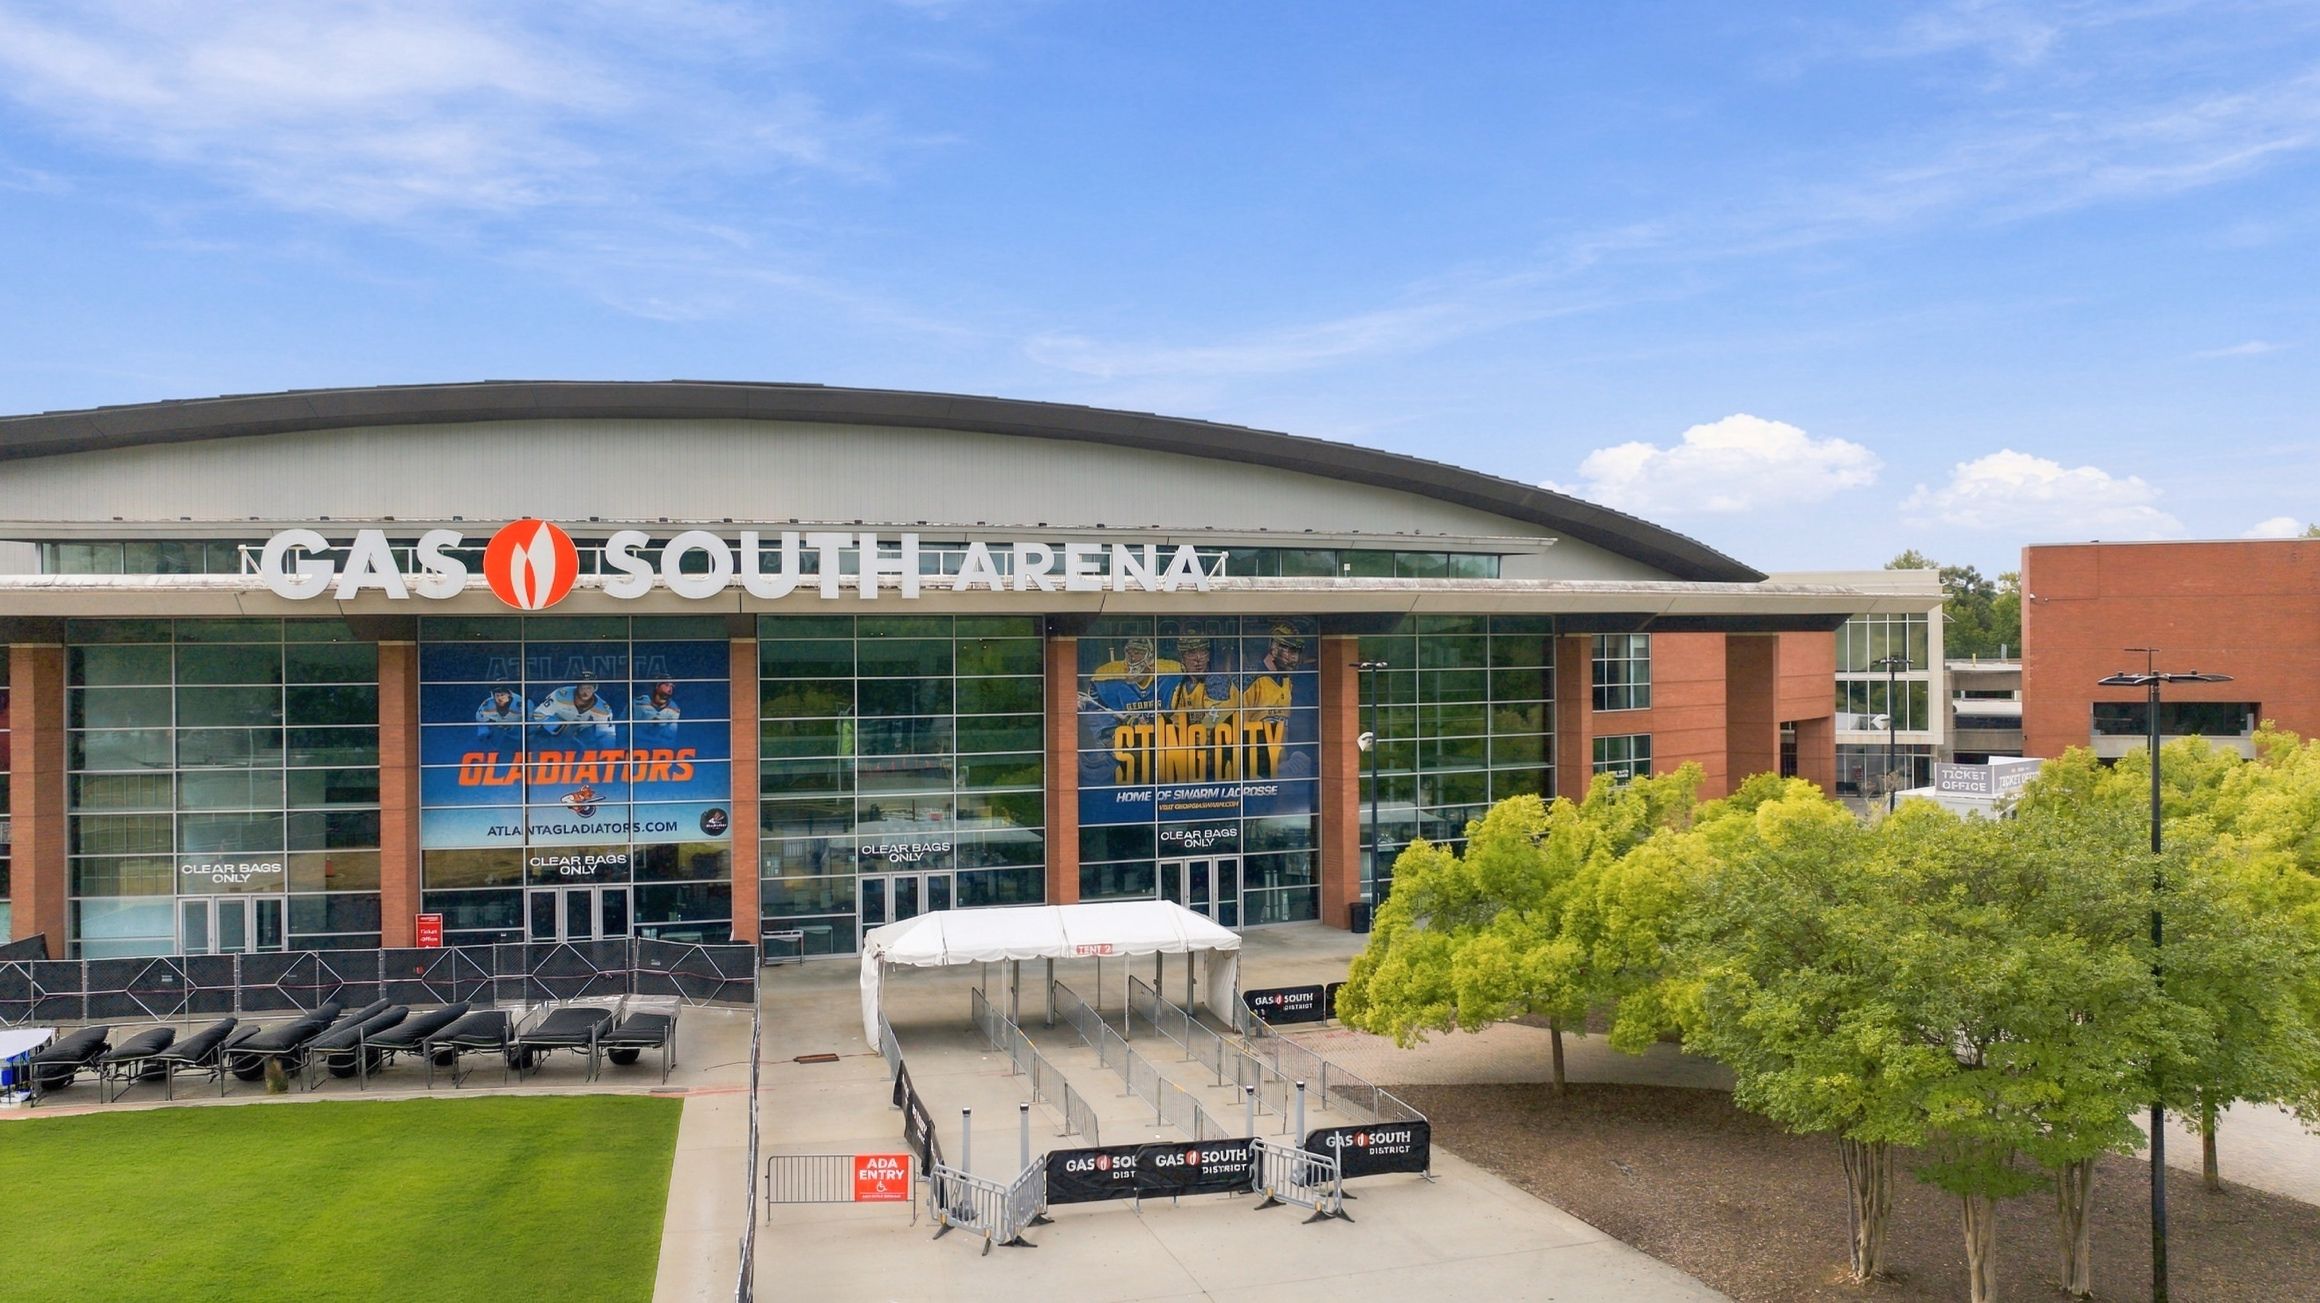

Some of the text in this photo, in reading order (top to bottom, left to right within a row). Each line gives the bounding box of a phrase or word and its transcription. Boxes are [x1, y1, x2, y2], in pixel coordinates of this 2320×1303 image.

[260, 529, 1211, 600] GAS SOUTH ARENA
[486, 655, 670, 680] ATLANTA
[1114, 710, 1285, 785] STING CITY
[458, 748, 697, 787] GLADIATORS
[1942, 769, 1987, 780] TICKET
[1942, 780, 1987, 791] OFFICE
[1116, 785, 1278, 803] HOME OF SWARM LACROSSE
[487, 821, 678, 837] ATLANTAGLADIATORS.COM
[1160, 828, 1238, 841] CLEAR BAGS
[861, 842, 951, 854] CLEAR BAGS
[1184, 838, 1215, 848] ONLY
[529, 854, 627, 867] CLEAR BAGS
[889, 853, 924, 862] ONLY
[181, 863, 282, 874] CLEAR BAGS
[560, 865, 597, 875] ONLY
[212, 873, 251, 883] ONLY
[1077, 945, 1111, 956] TENT 2
[1255, 992, 1314, 1006] GAS SOUTH
[1284, 1003, 1313, 1011] DISTRICT
[1326, 1131, 1411, 1148] GAS SOUTH
[1369, 1146, 1411, 1155] DISTRICT
[867, 1158, 898, 1169] ADA
[1066, 1155, 1137, 1173] GAS SOU
[1155, 1149, 1248, 1168] GAS SOUTH
[1202, 1163, 1248, 1174] DISTRICT
[859, 1169, 905, 1180] ENTRY
[1112, 1170, 1136, 1180] DIST
